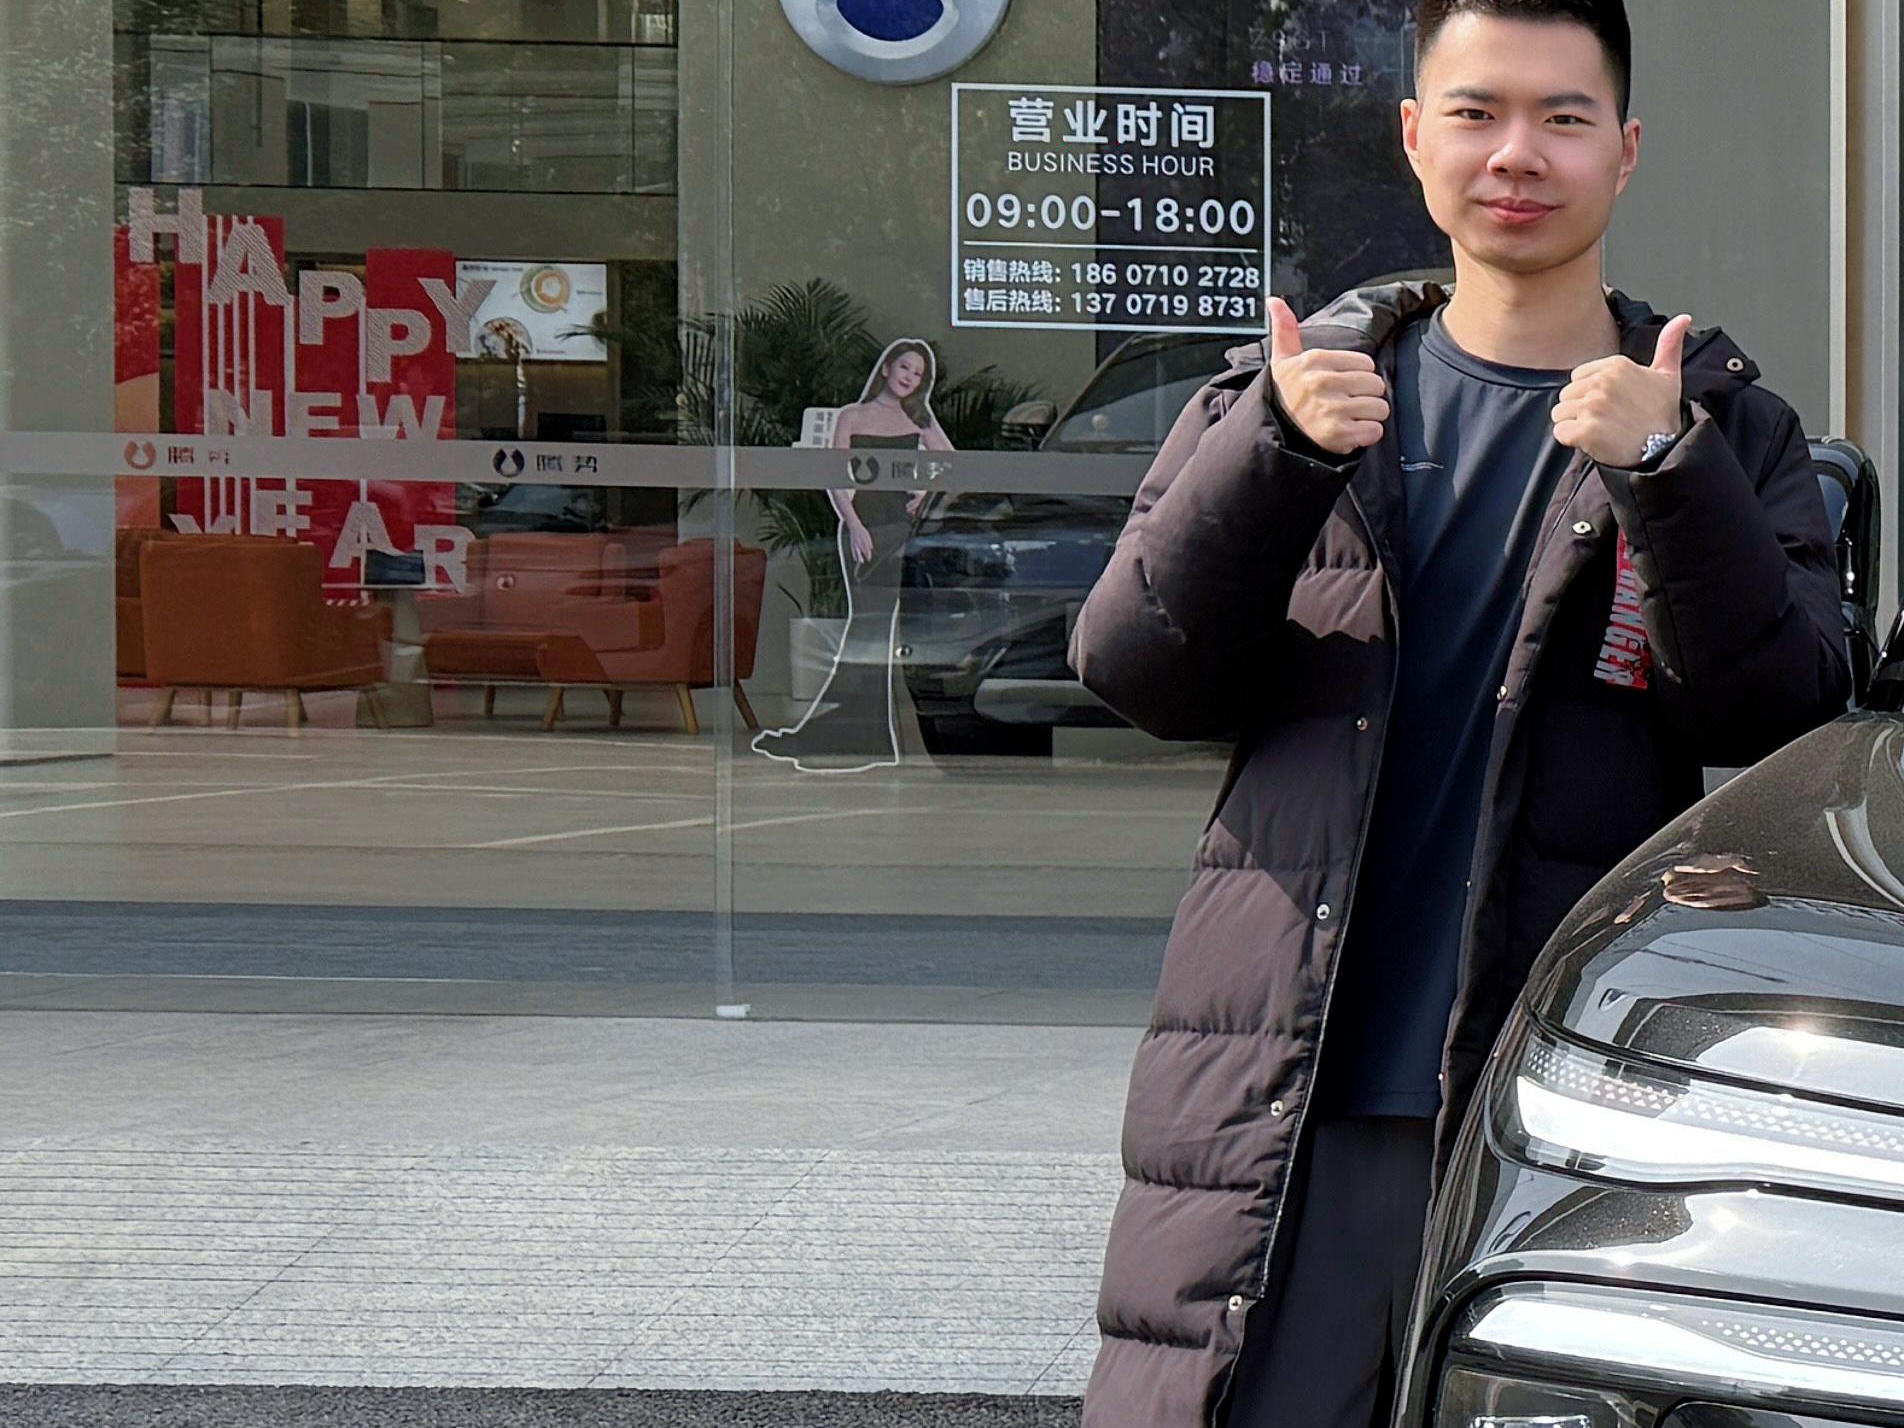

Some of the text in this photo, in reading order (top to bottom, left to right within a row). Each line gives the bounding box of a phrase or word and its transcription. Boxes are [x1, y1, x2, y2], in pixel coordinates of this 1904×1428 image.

[1252, 60, 1363, 86] 稳定通过
[1008, 96, 1215, 148] 营业时间
[1007, 151, 1215, 177] BUSINESS HOUR
[966, 192, 1255, 236] 09:00-18:00
[127, 187, 496, 383] HAPPY
[1071, 263, 1117, 286] 186
[1126, 264, 1189, 288] 0710
[1198, 266, 1260, 289] 2728
[1071, 292, 1116, 315] 137
[1126, 294, 1189, 317] 0719
[1198, 295, 1258, 318] 8731
[205, 388, 447, 440] NEW
[170, 488, 479, 594] EAR
